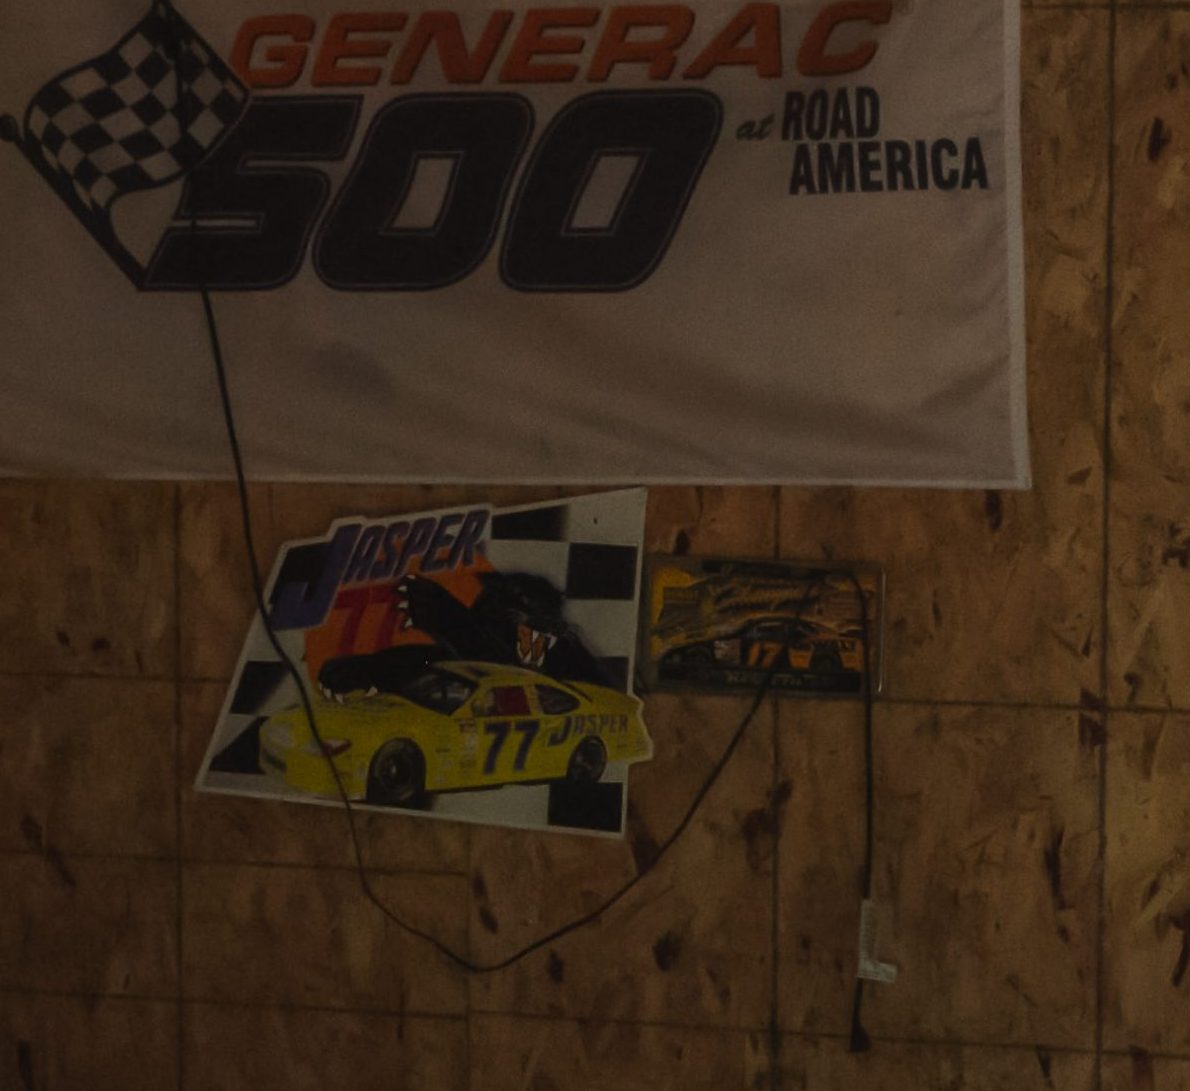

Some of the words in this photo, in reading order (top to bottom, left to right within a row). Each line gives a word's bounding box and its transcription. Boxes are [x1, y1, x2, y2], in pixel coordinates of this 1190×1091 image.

[227, 0, 894, 88] GENERAC
[735, 112, 775, 140] at
[781, 86, 881, 141] ROAD
[138, 88, 725, 292] 500
[789, 137, 989, 195] AMERICA
[270, 508, 491, 631] JASPER
[483, 718, 540, 776] 77
